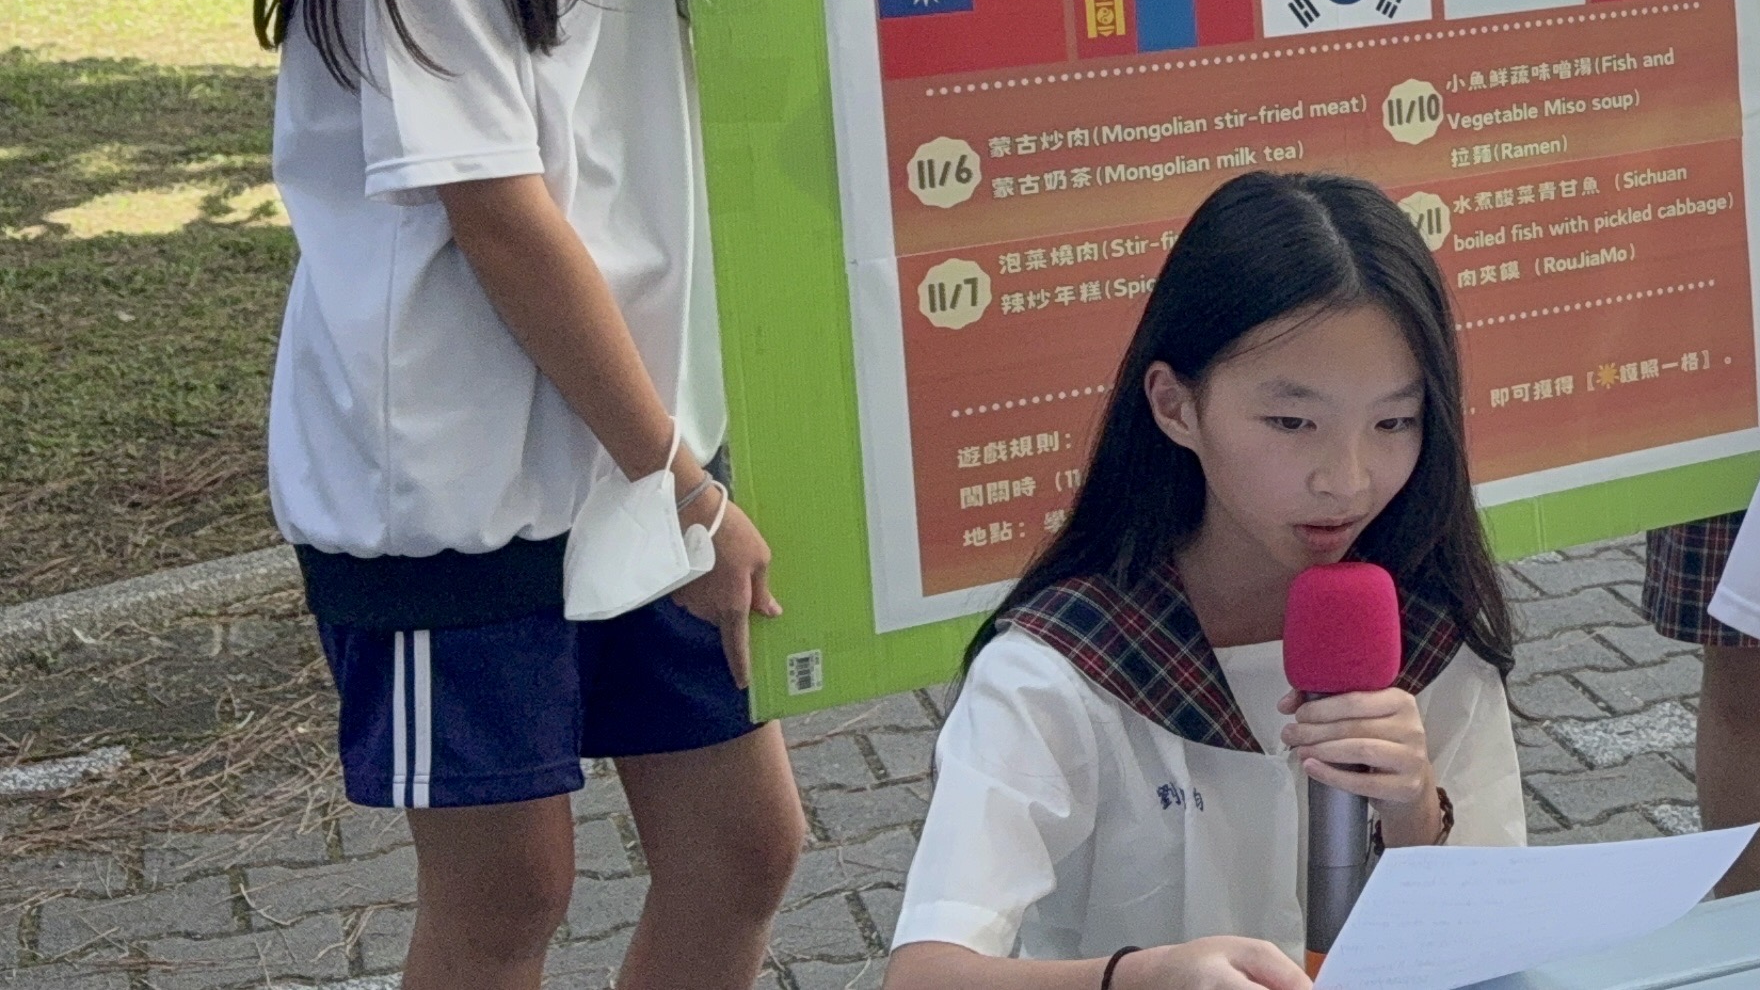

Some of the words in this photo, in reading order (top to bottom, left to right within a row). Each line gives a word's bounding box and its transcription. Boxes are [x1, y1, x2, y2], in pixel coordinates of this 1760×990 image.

[1643, 47, 1675, 69] and
[1214, 100, 1303, 131] stir-fried
[1309, 95, 1367, 118] meat)
[1387, 93, 1440, 127] 11/10
[1447, 102, 1538, 130] Vegetable
[1544, 97, 1586, 117] Miso
[1591, 89, 1640, 111] soup)
[917, 155, 974, 190] 11/6
[1217, 147, 1257, 170] milk
[1264, 141, 1305, 163] tea)
[1454, 226, 1506, 252] boiled
[1511, 222, 1543, 242] fish
[1549, 215, 1589, 236] with
[1594, 203, 1652, 233] pickled
[1657, 192, 1735, 220] cabbage)
[927, 277, 979, 314] 11/7
[1105, 274, 1157, 299] (Spic
